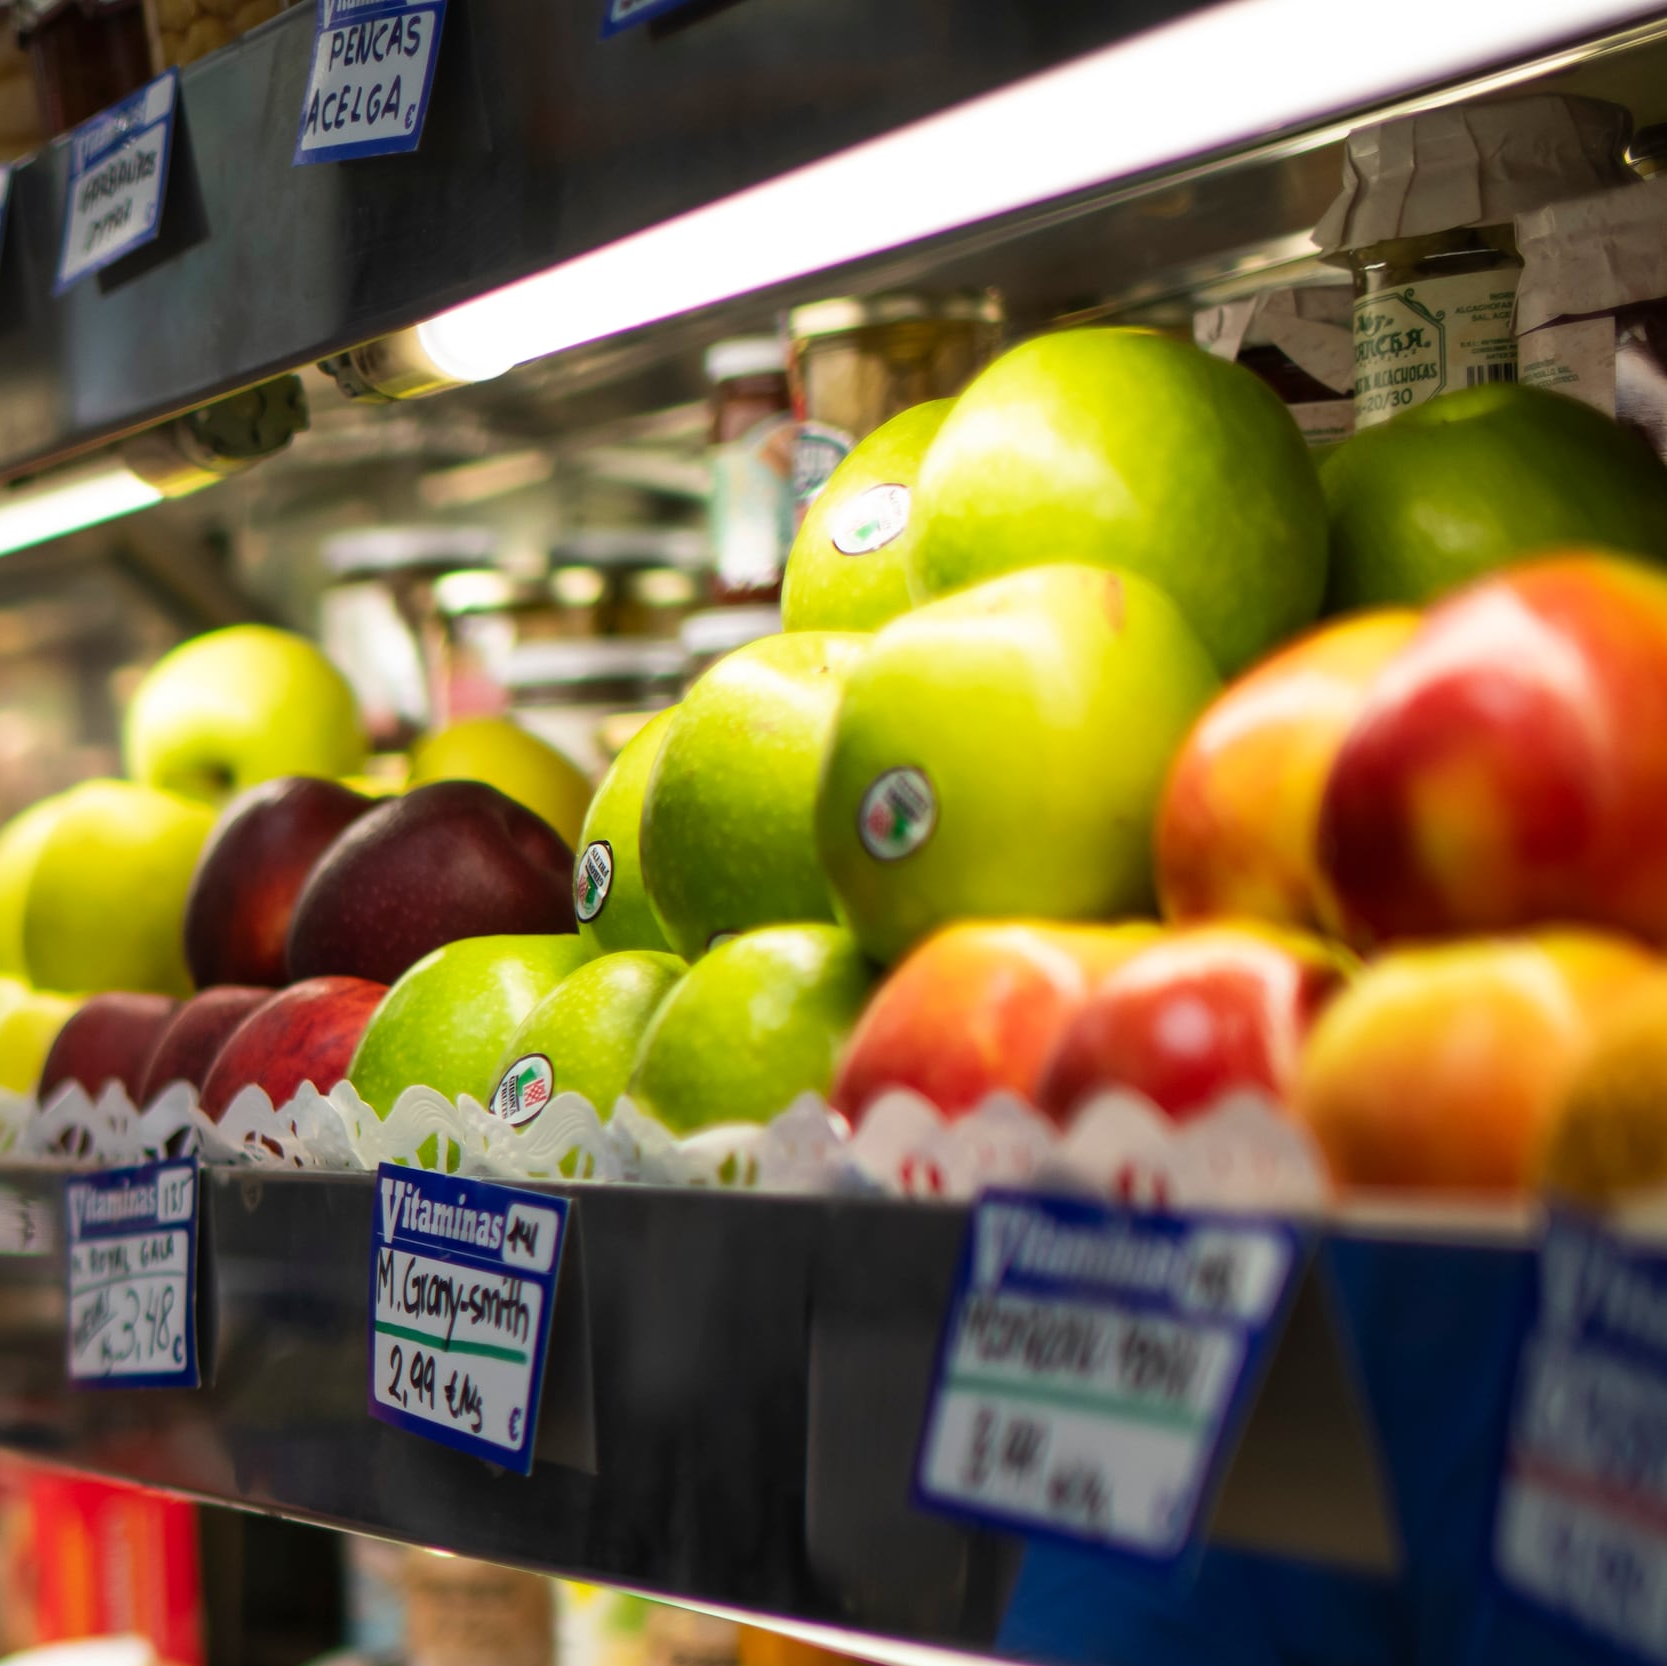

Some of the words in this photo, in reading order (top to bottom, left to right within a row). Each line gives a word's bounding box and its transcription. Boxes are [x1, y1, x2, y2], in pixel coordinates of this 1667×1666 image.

[329, 16, 422, 72] PENCAS
[304, 74, 402, 136] ACELGA
[1374, 363, 1438, 388] ALCACHOFAS
[69, 1177, 156, 1239] Vitaminas
[381, 1177, 504, 1250] Vitaminas
